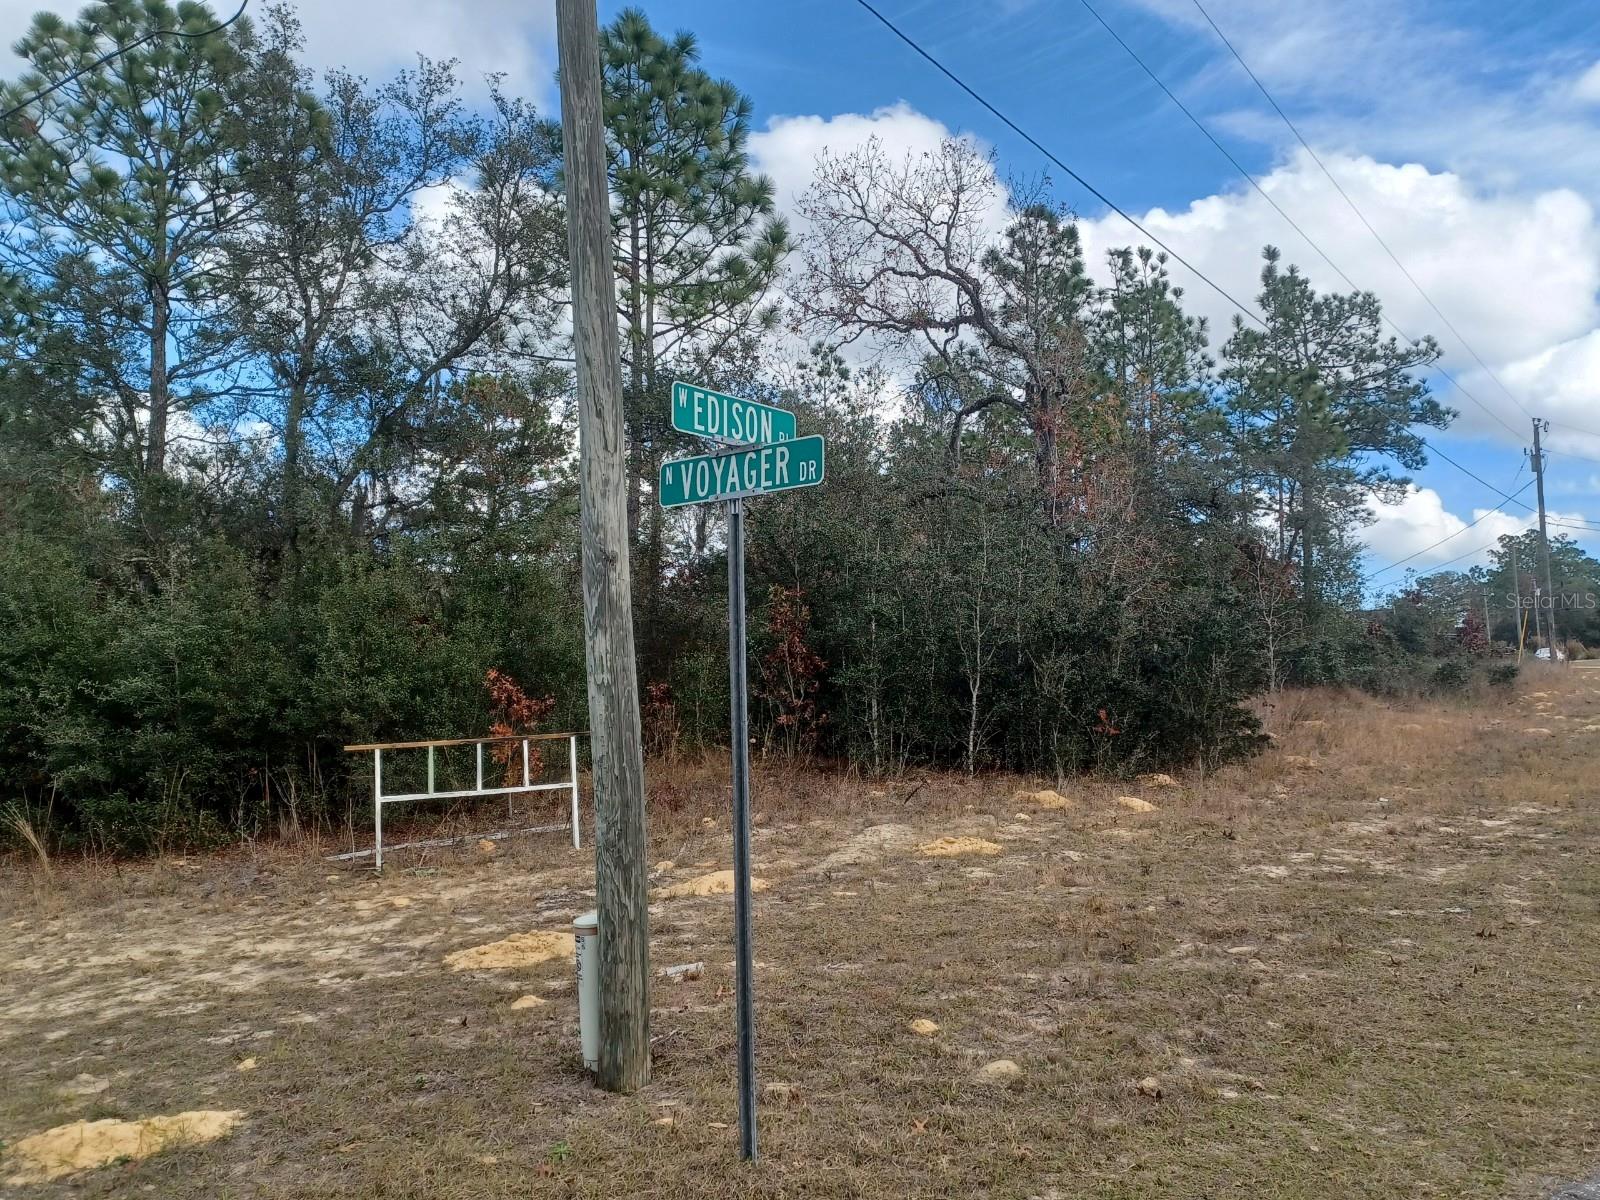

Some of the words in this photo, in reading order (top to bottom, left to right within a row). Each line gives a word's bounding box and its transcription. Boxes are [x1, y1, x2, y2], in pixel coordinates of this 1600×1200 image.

[678, 387, 688, 408] W
[694, 391, 772, 444] EDISON
[665, 466, 673, 486] N
[681, 446, 790, 500] VOYAGER
[799, 460, 817, 482] DR
